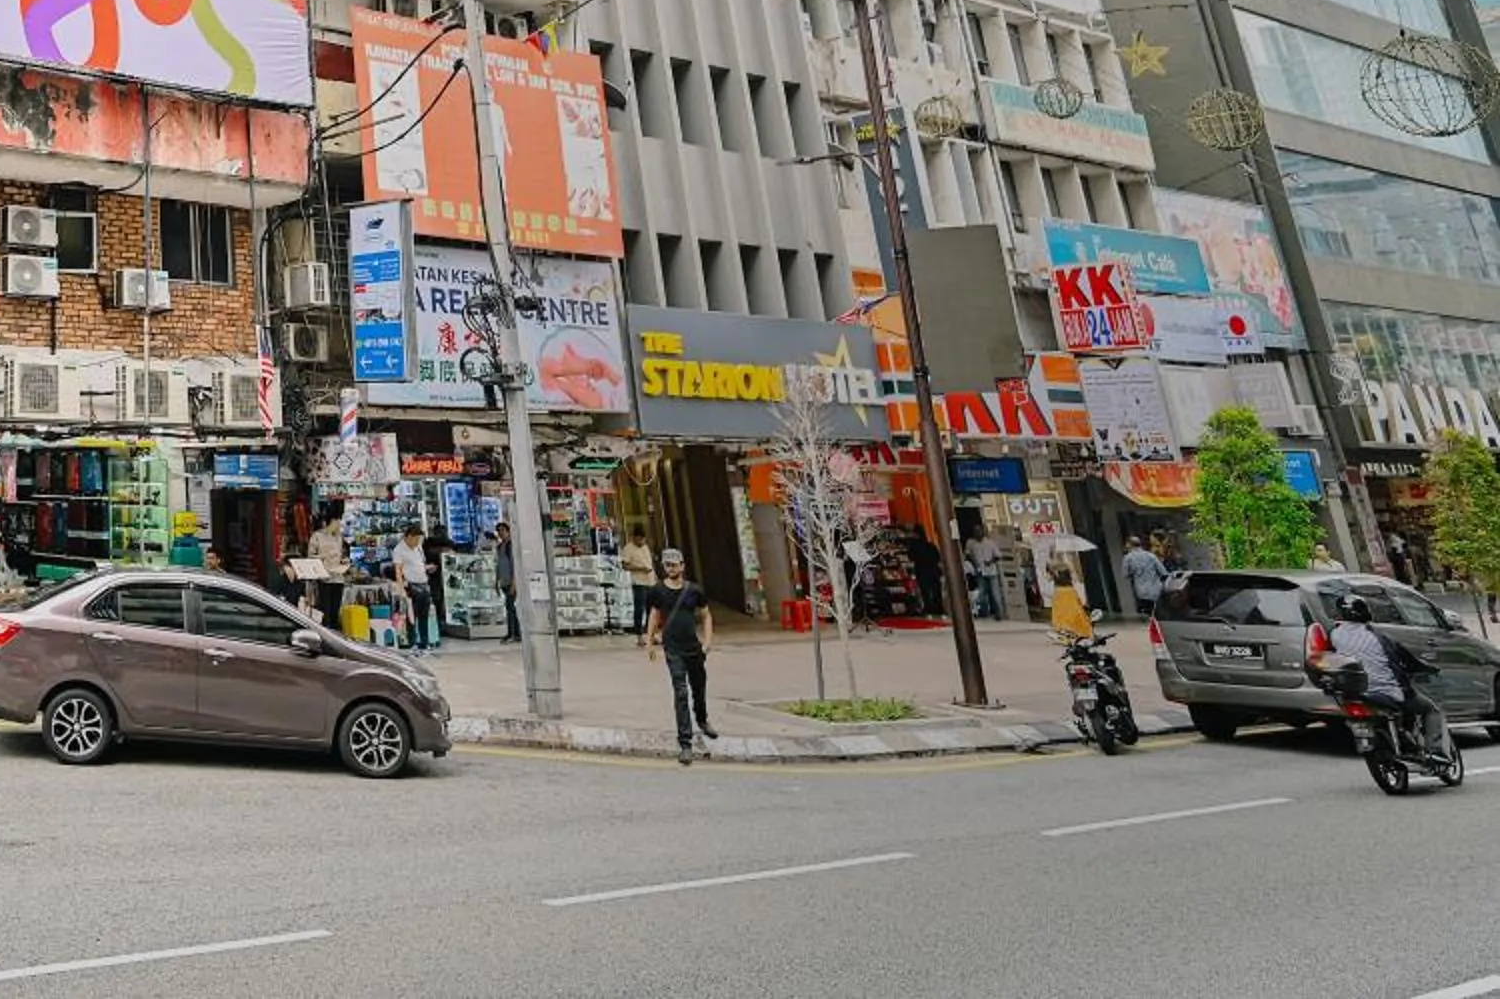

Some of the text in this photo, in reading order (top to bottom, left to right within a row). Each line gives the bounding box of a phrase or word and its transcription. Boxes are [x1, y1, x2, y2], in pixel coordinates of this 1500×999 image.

[1056, 264, 1125, 309] KK
[640, 331, 684, 354] THE
[1085, 307, 1113, 346] 24
[1109, 305, 1140, 345] JAM
[642, 357, 786, 403] STARION
